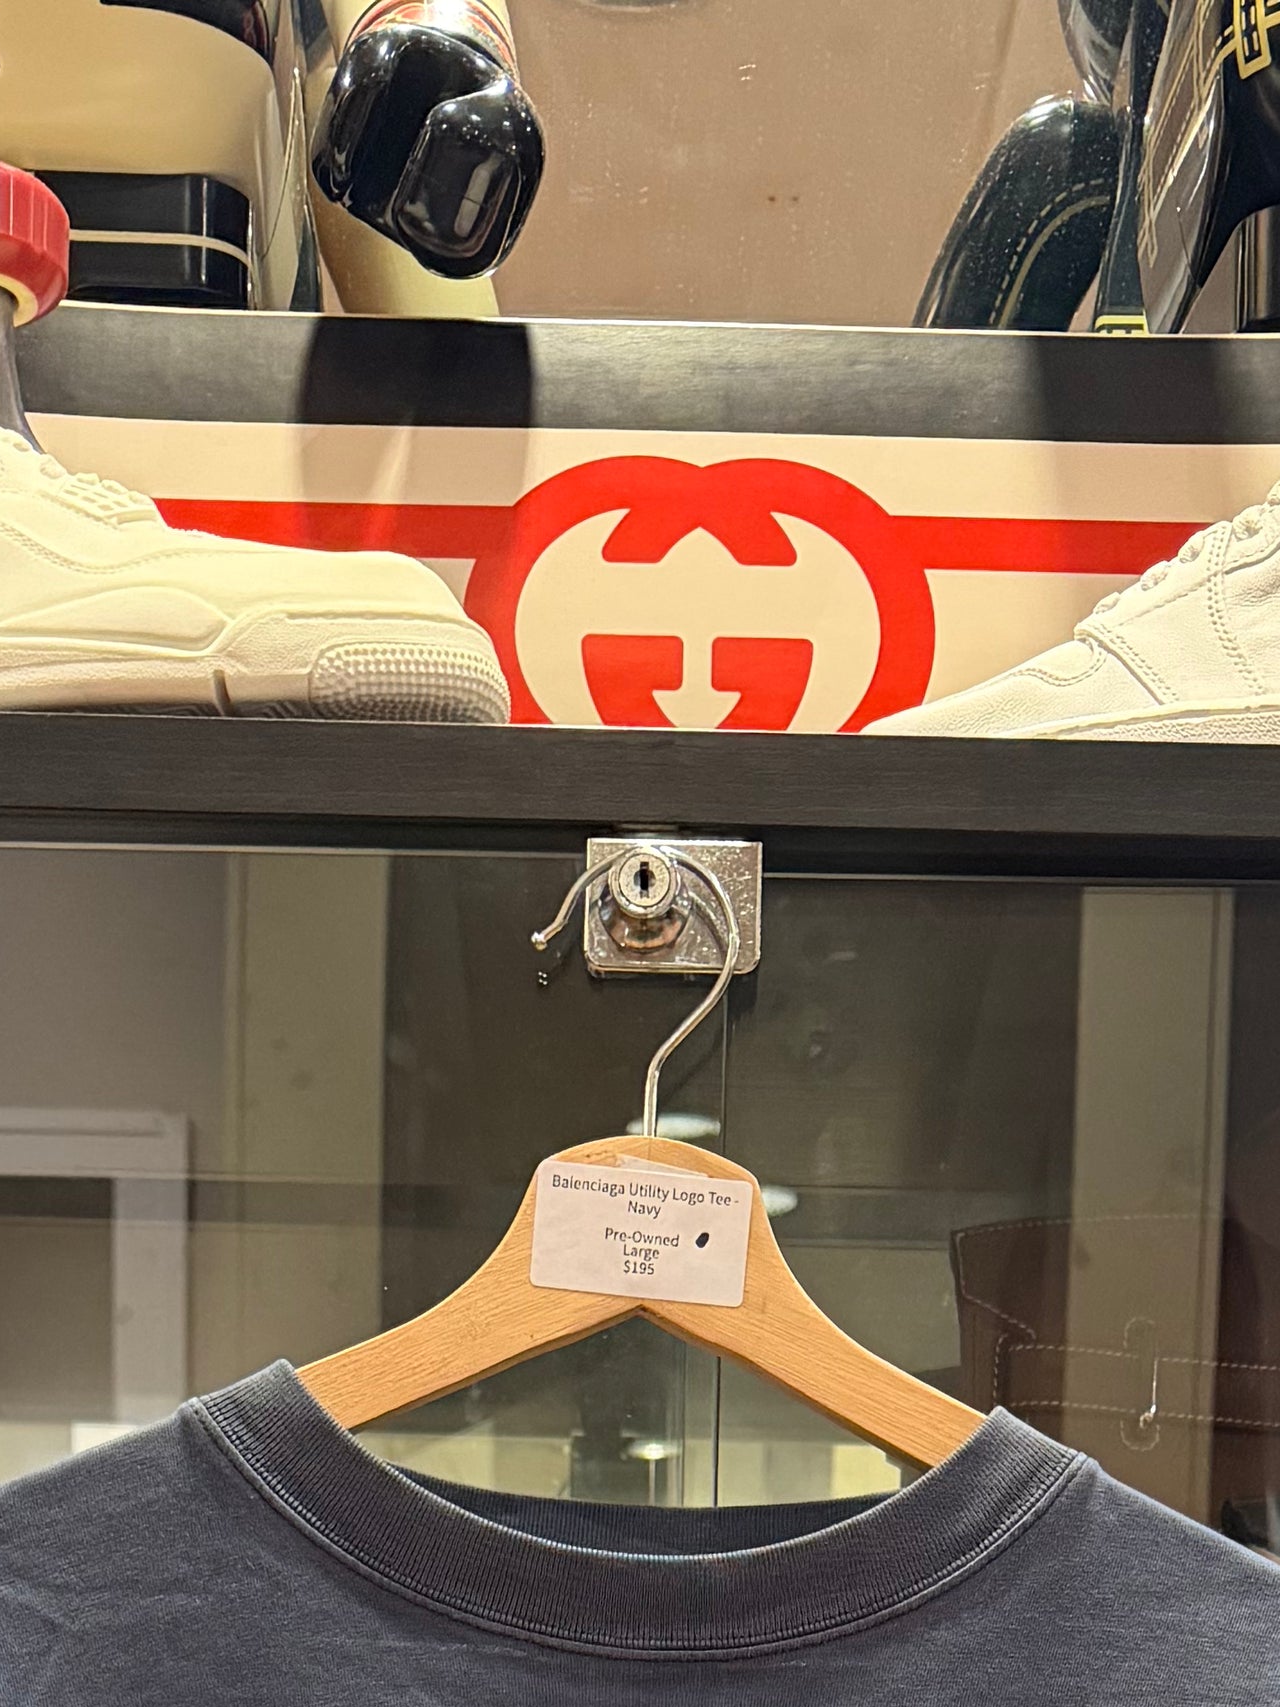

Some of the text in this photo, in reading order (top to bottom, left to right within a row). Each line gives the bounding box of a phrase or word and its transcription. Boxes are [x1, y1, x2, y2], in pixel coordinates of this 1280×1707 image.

[552, 1174, 625, 1197] Balenciaga
[629, 1183, 670, 1202] Utility
[672, 1188, 705, 1206] Logo
[708, 1191, 732, 1206] Tee
[627, 1200, 662, 1219] Navy
[605, 1227, 680, 1248] Pre-Owned
[623, 1244, 660, 1262] Large
[623, 1259, 655, 1275] $195
